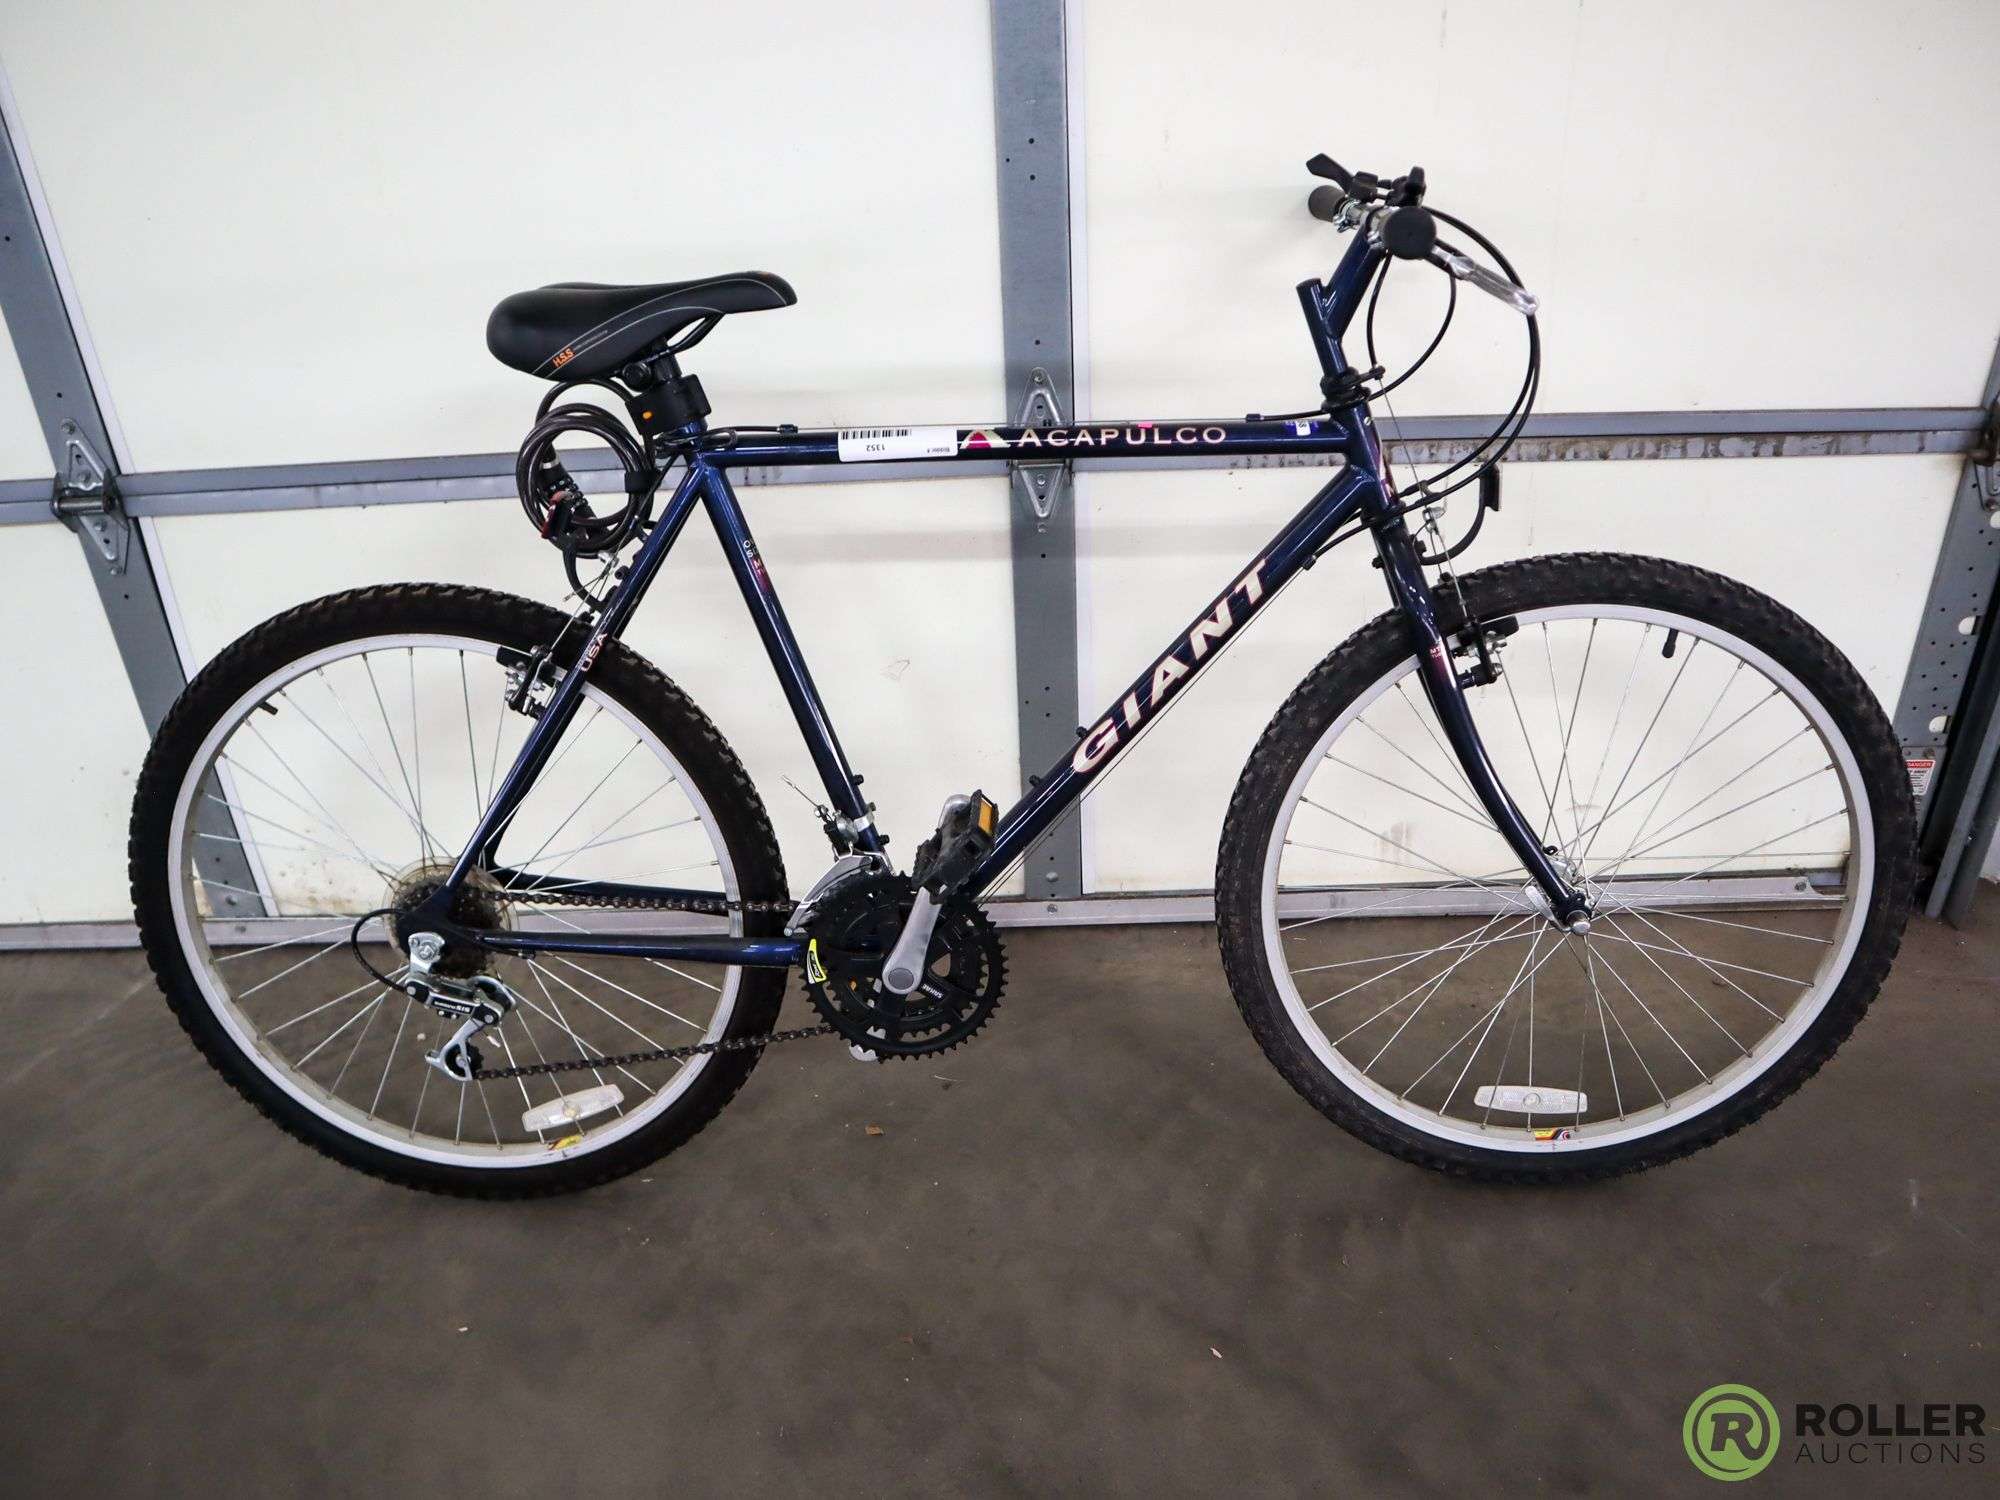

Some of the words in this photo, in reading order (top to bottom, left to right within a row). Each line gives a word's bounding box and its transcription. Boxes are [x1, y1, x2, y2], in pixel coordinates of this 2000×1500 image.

[1018, 427, 1226, 447] ACAPULCO
[580, 633, 608, 671] USA
[1072, 558, 1266, 773] GIANT
